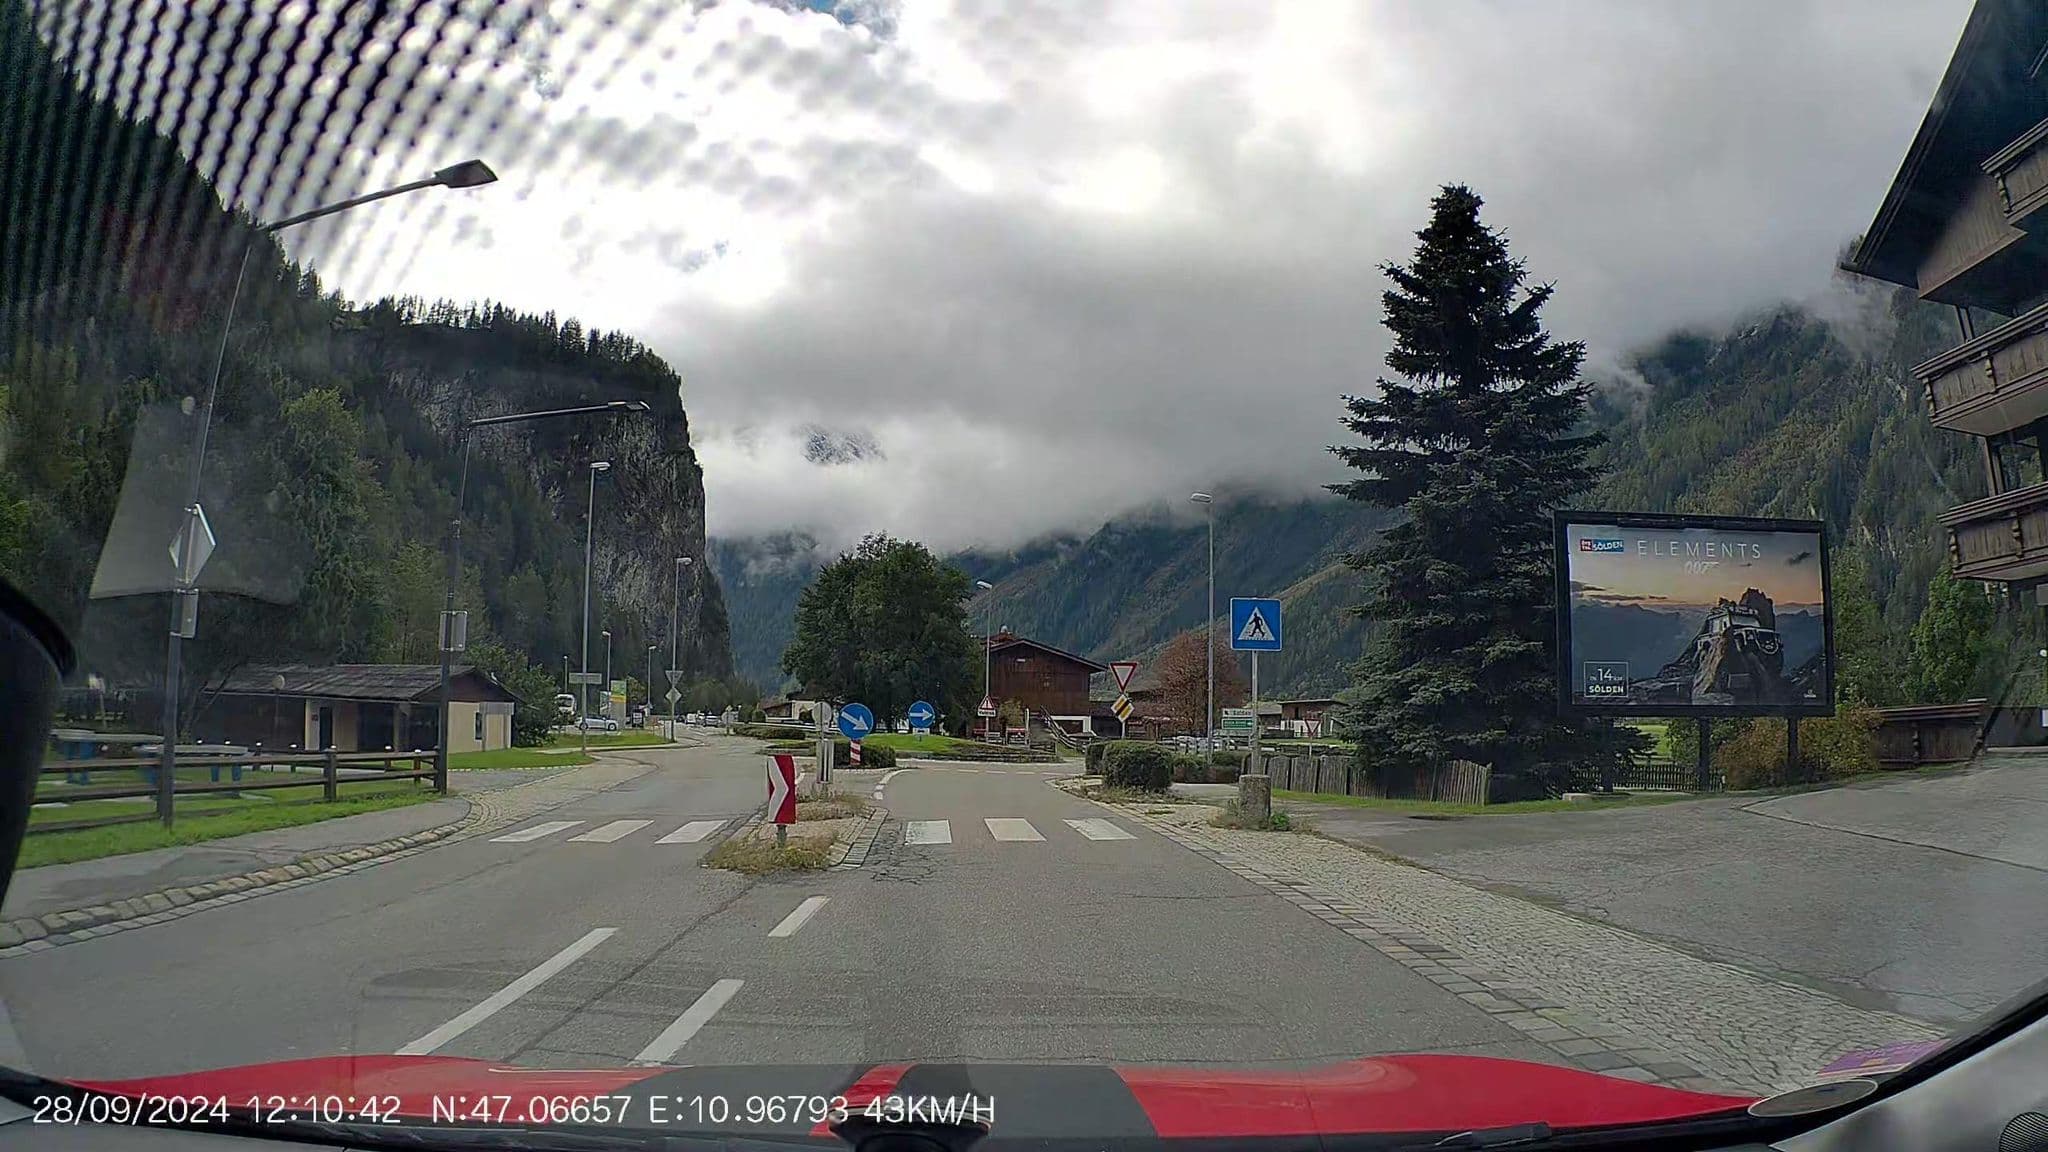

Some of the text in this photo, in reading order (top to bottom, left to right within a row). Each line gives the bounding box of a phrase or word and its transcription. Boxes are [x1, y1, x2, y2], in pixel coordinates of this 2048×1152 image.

[1637, 541, 1761, 559] ELEMENTS
[1597, 668, 1613, 681] 14
[1588, 684, 1624, 693] SÖLDEN
